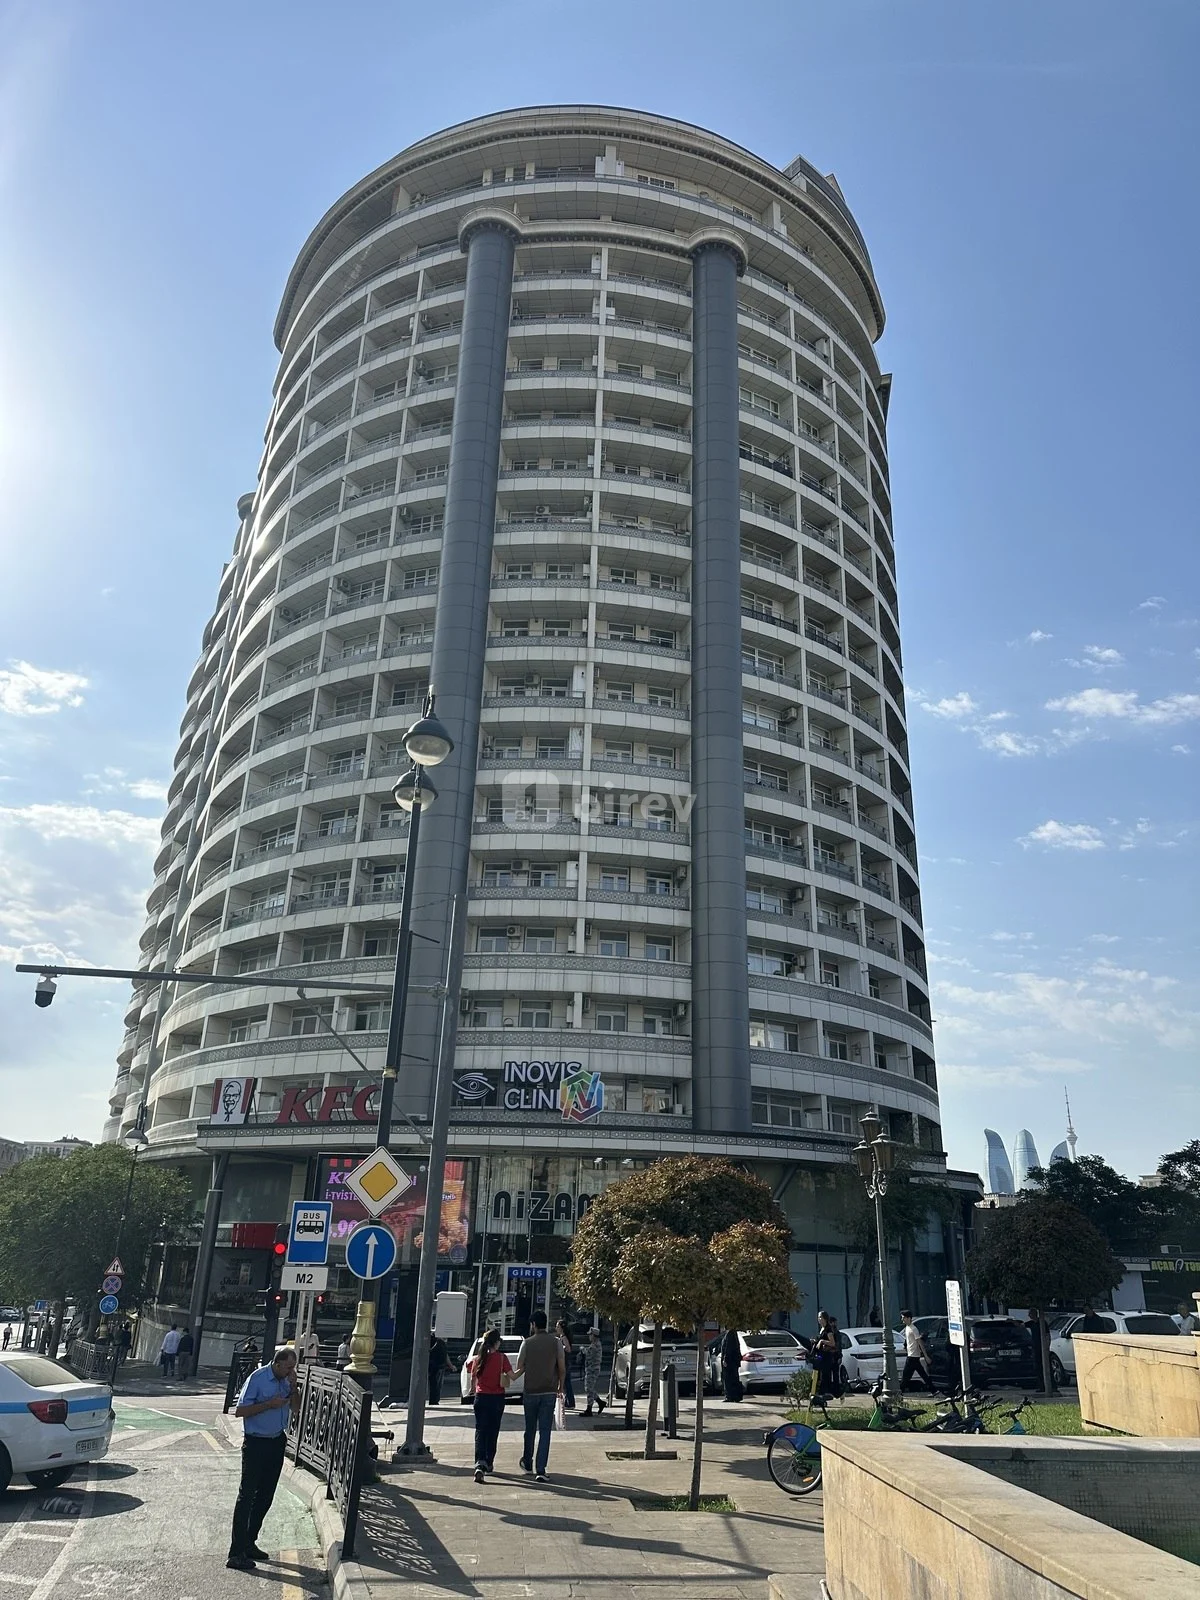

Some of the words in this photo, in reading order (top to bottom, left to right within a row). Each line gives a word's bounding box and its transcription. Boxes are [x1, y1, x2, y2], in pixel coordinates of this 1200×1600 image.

[503, 1061, 582, 1083] INOVIS
[274, 1084, 382, 1123] KFC
[503, 1088, 570, 1110] CLINI
[303, 1212, 321, 1220] BUS
[295, 1273, 314, 1284] M2
[512, 1267, 543, 1278] GİRİŞ
